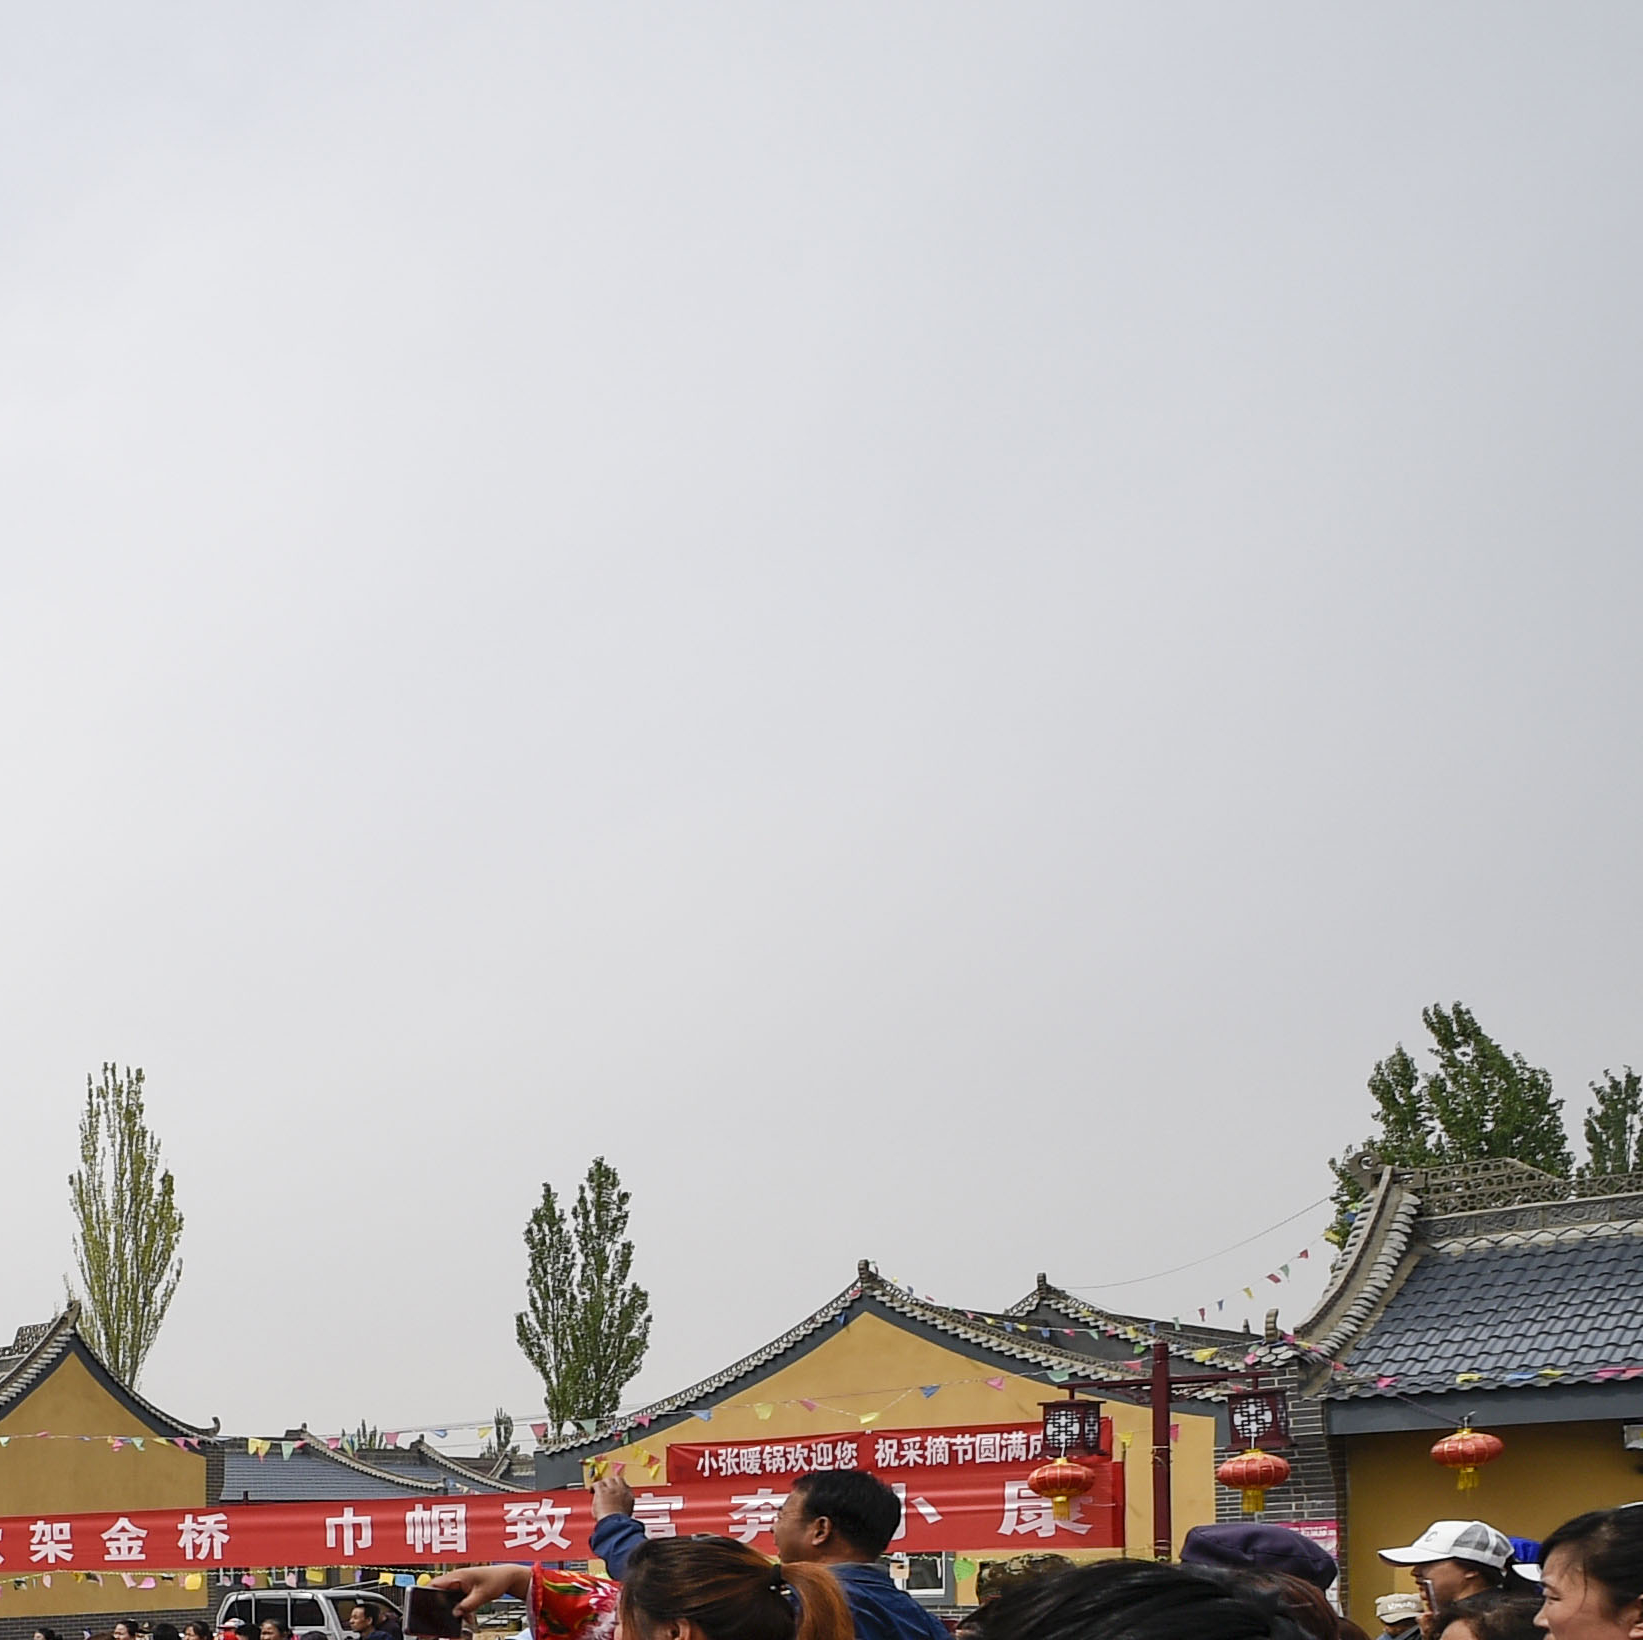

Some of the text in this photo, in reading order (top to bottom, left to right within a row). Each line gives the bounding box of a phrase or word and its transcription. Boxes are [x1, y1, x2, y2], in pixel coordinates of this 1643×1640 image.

[697, 1440, 859, 1477] 小张暖锅欢迎您
